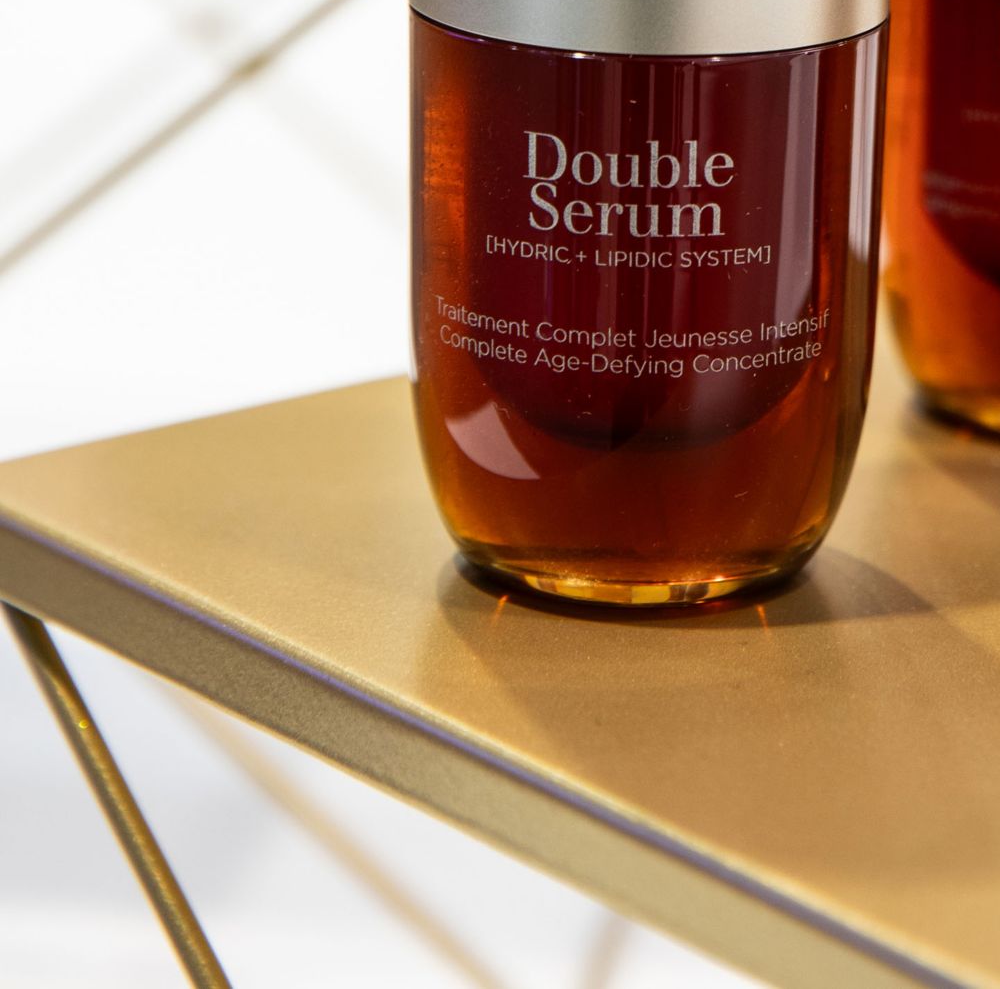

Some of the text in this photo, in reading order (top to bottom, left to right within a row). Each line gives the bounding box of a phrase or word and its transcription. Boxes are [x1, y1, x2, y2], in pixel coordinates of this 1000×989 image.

[523, 130, 736, 188] Double
[528, 182, 726, 238] Serum
[485, 234, 771, 268] [HYDRIC + LIPIDIC SYSTEM]
[434, 295, 830, 349] Traitement Complet Jeunesse Intensif
[440, 324, 823, 379] Complete Age-Defying Concentrate
